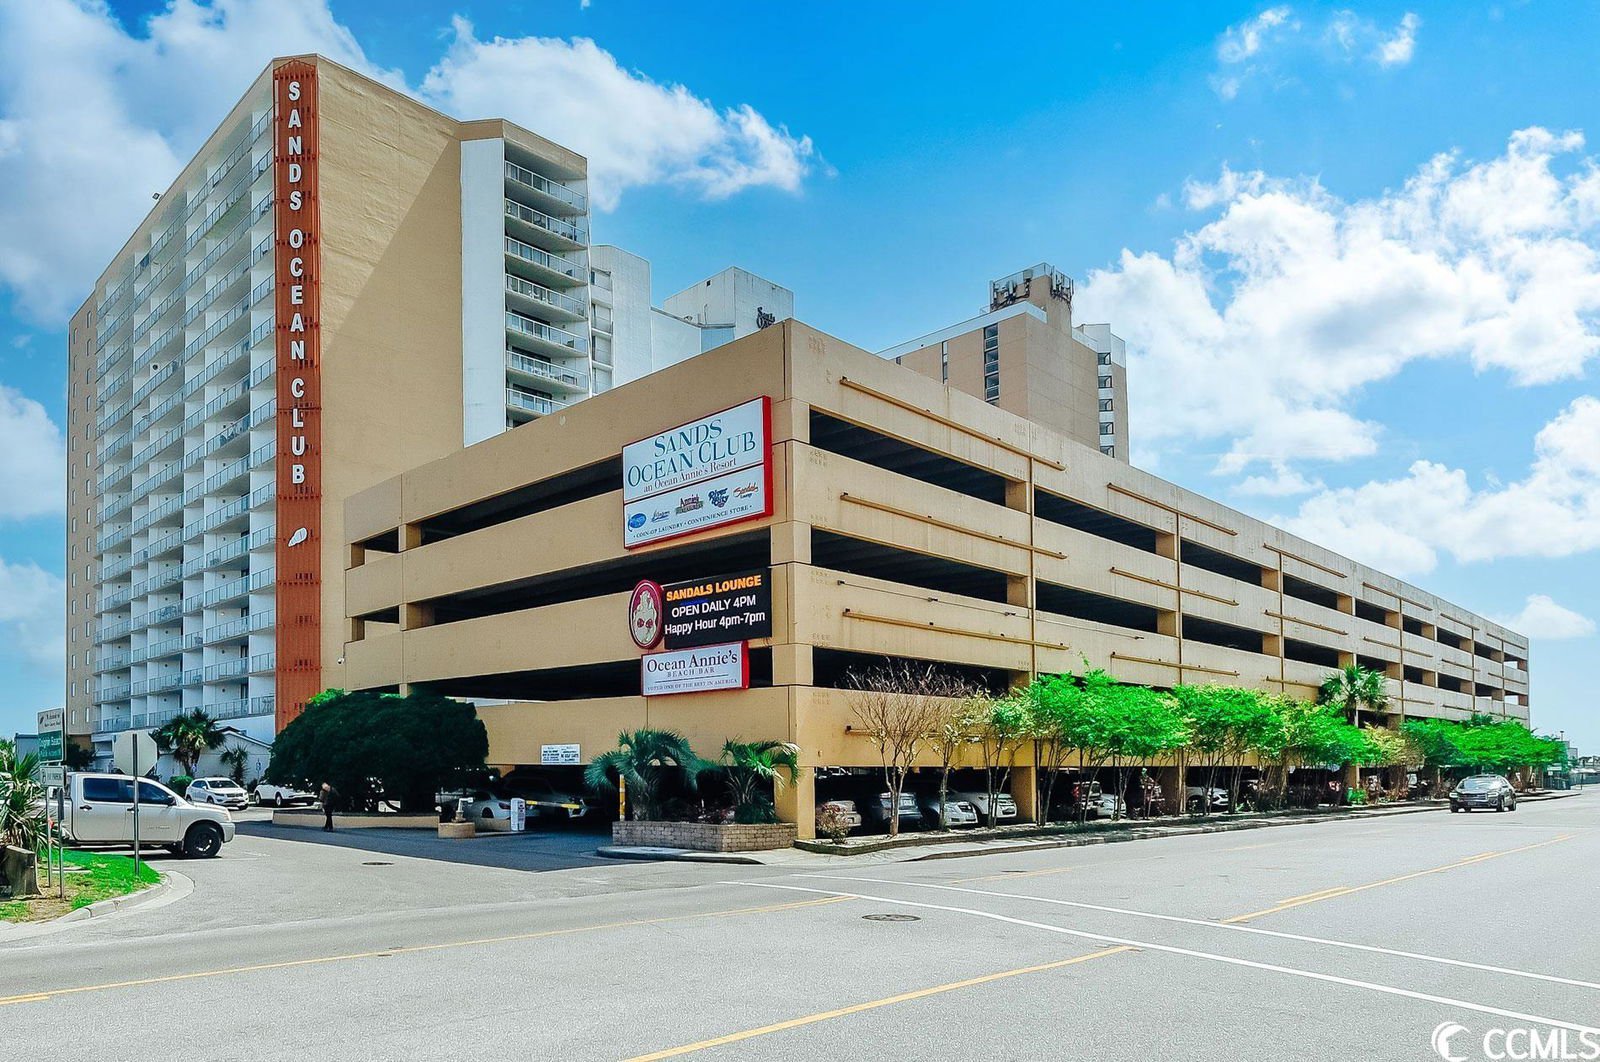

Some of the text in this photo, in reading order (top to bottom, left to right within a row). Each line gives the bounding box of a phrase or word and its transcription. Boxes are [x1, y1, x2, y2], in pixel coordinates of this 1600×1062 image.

[288, 81, 305, 485] SANDS OCEAN CLUB
[654, 418, 722, 457] SANDS
[628, 431, 756, 487] OCEAN CLUB
[654, 474, 681, 488] Ocean
[680, 464, 708, 482] Annie's
[710, 457, 737, 474] Resort
[636, 528, 658, 538] COIN-OP
[658, 521, 684, 533] LAUNDRY
[687, 510, 728, 526] CONVENIENCE
[729, 504, 749, 514] STORE
[666, 574, 762, 601] SANDALS LOUNGE
[671, 594, 756, 618] OPEN DAILY 4PM
[664, 611, 765, 636] Happy Hour 4pm-7pm
[647, 649, 738, 673] Ocean Annie's
[667, 666, 715, 678] BEACH BAR
